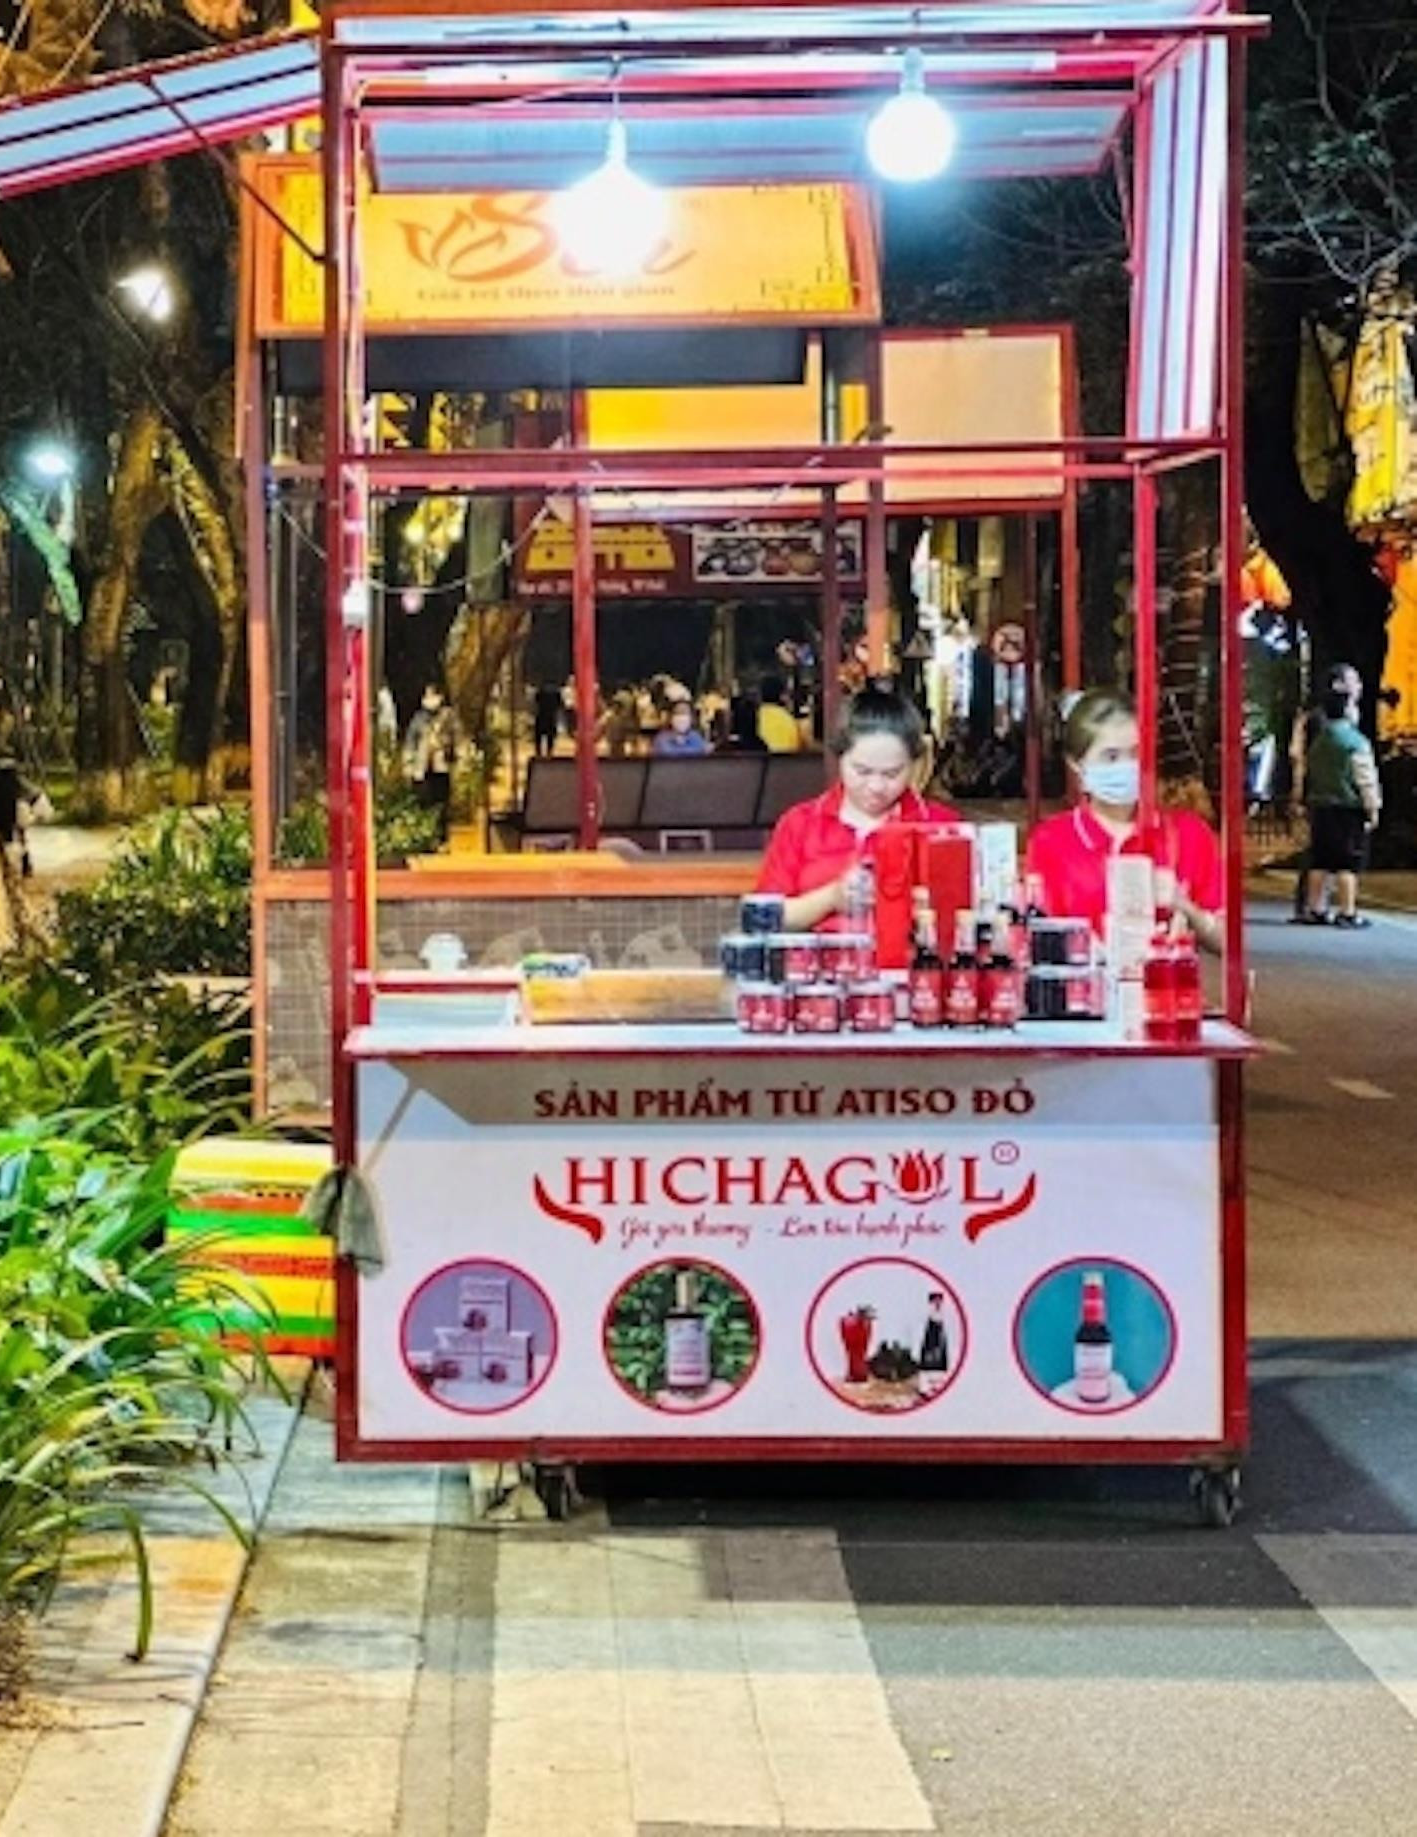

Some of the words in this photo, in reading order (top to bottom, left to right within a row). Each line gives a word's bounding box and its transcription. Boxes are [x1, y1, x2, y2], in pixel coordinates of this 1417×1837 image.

[534, 1080, 618, 1118] SẢN
[633, 1077, 751, 1117] PHẨM
[765, 1081, 824, 1116] TỪ
[833, 1088, 957, 1116] ATISO
[971, 1077, 1035, 1115] ĐỎ
